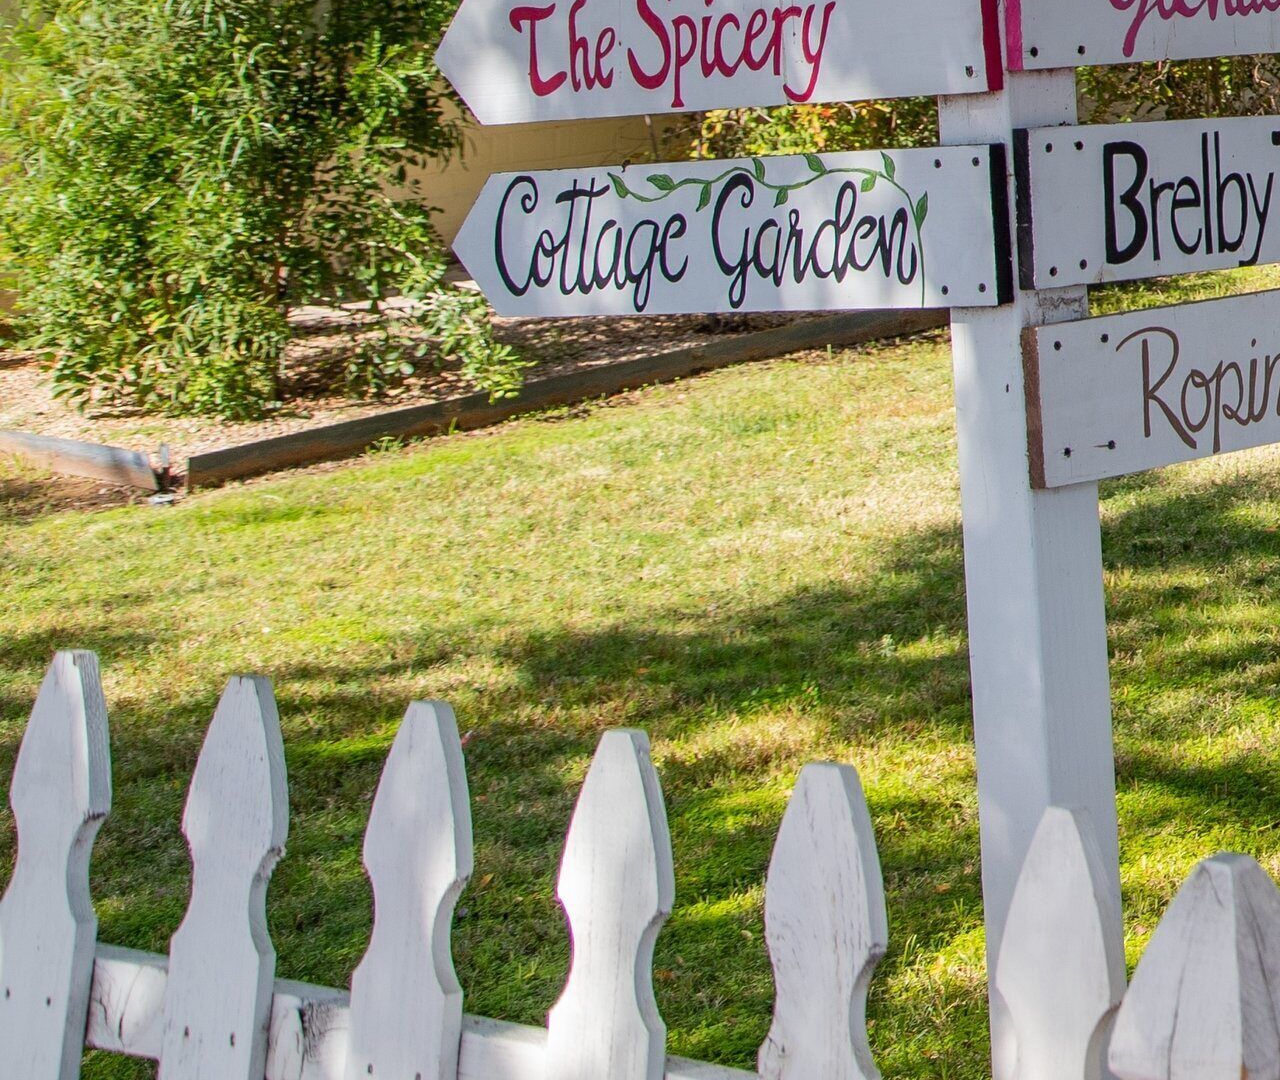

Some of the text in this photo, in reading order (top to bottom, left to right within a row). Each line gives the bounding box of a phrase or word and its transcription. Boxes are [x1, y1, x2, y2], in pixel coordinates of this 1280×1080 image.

[495, 174, 918, 312] Cottage Garden
[1102, 131, 1274, 266] Brelby
